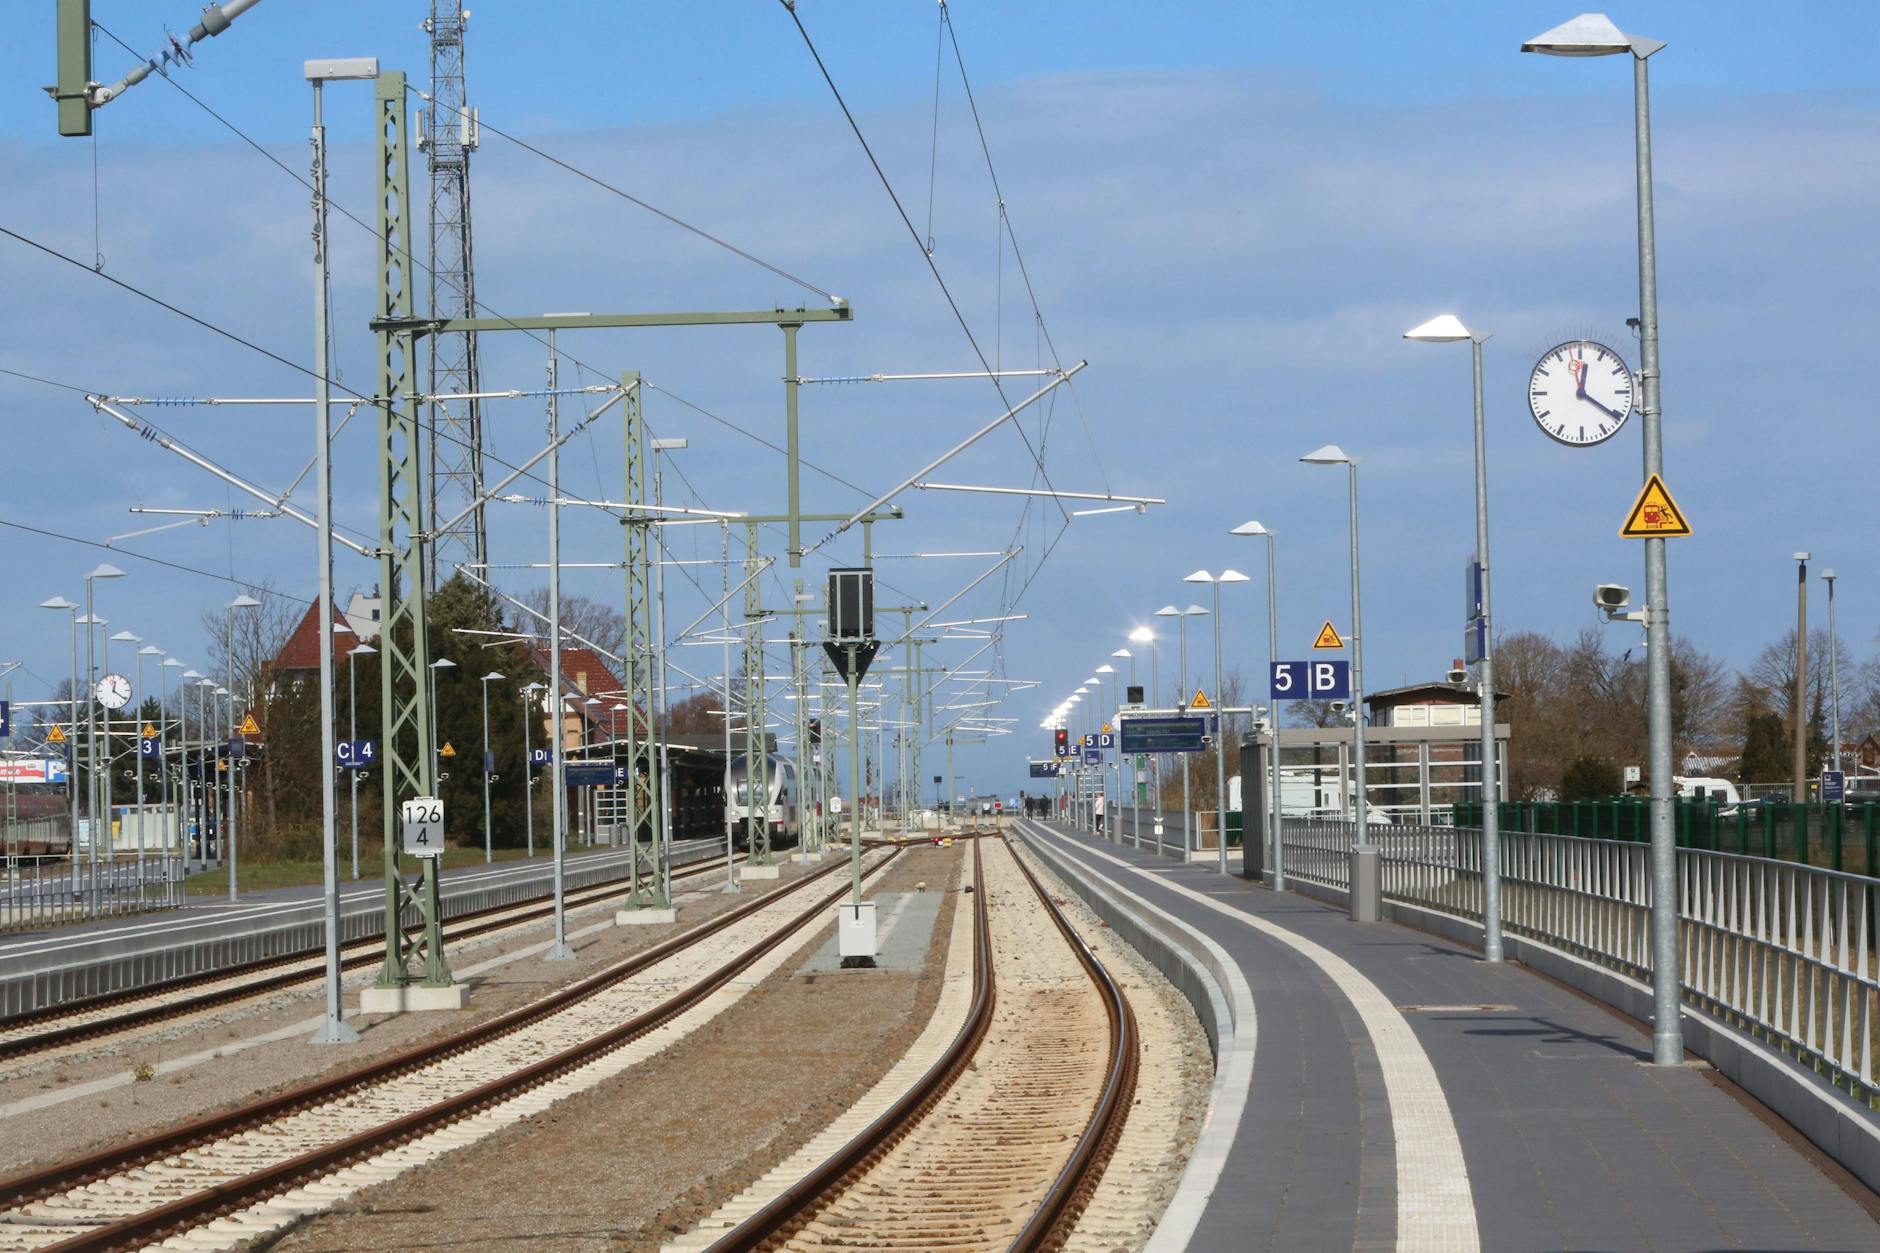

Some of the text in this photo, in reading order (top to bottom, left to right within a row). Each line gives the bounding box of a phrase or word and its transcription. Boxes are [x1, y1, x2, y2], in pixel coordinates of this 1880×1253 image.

[1275, 663, 1336, 691] 5 B
[1086, 735, 1094, 746] 5
[1101, 734, 1110, 746] D
[143, 740, 152, 754] 3
[337, 742, 373, 759] C 4
[1059, 745, 1077, 755] 5 E
[535, 749, 544, 760] D
[618, 767, 625, 777] E
[1043, 763, 1049, 771] 5
[406, 805, 441, 824] 126
[416, 827, 428, 846] 4
